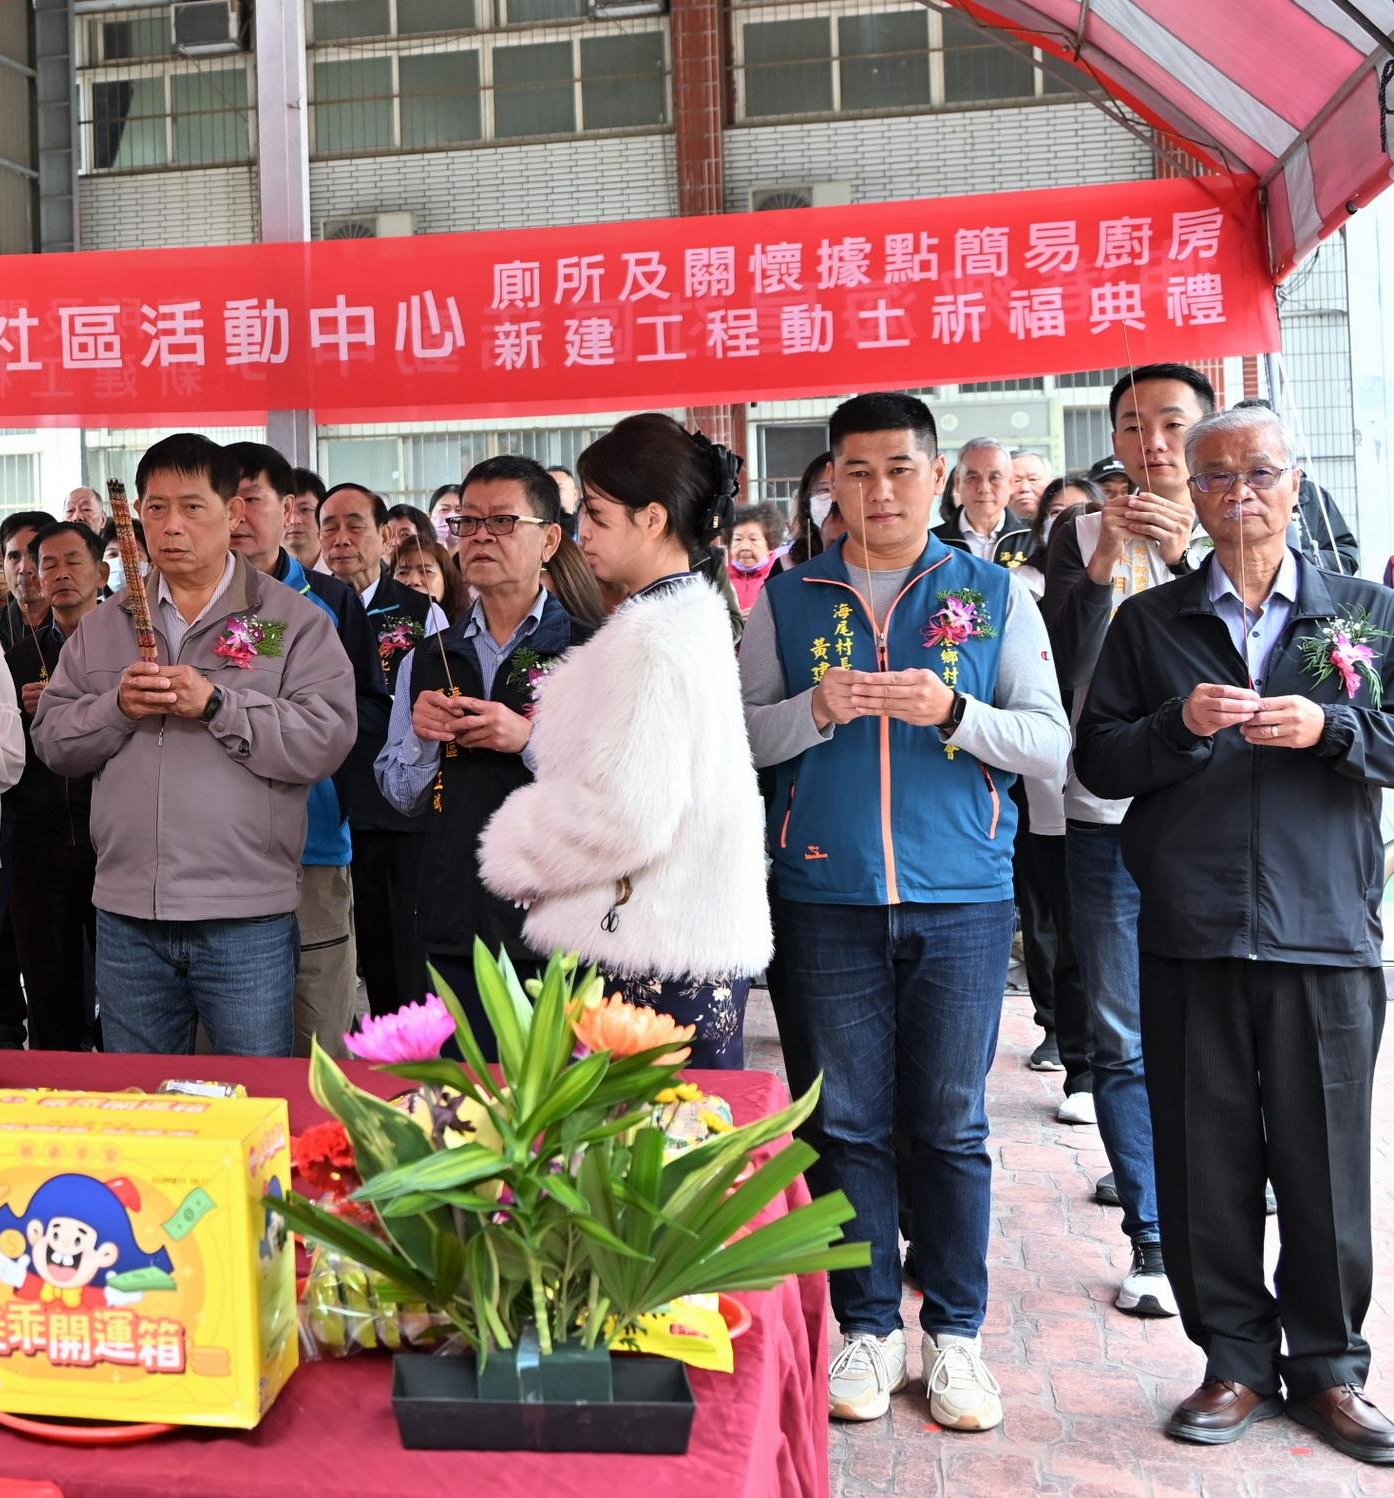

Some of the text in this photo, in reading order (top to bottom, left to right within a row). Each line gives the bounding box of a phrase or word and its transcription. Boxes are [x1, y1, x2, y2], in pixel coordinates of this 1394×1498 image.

[491, 207, 1224, 309] 廁所及關懷據點簡易廚房
[494, 272, 1227, 370] 新建工程動土祈福典禮
[833, 602, 854, 671] 海尾村長
[940, 639, 959, 689] 鄉村
